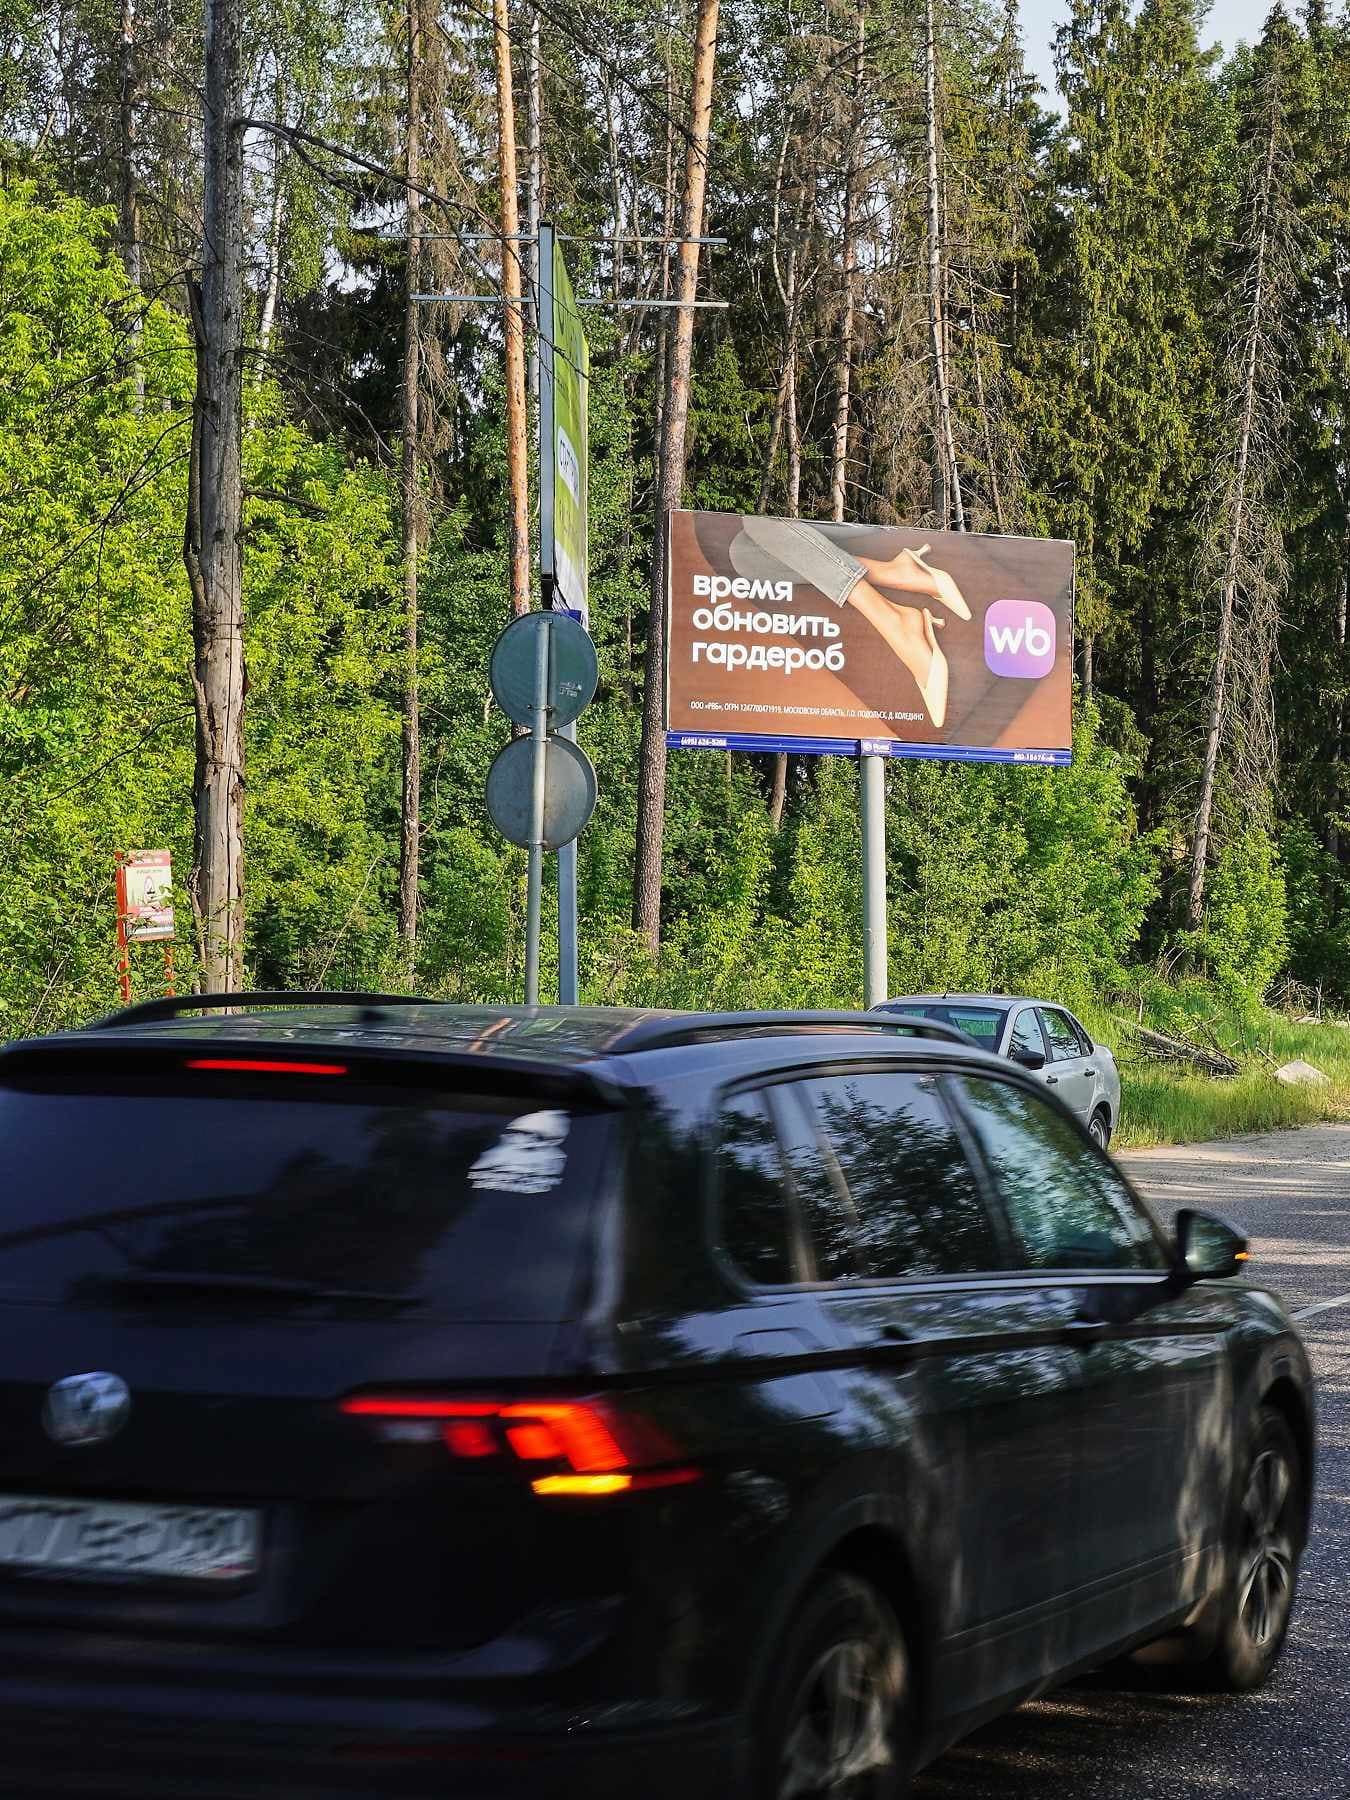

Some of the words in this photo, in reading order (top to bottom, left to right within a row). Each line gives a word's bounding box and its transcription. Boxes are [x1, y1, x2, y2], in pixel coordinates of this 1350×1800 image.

[693, 574, 793, 604] время
[692, 602, 841, 638] обновить
[989, 616, 1051, 657] wb
[691, 641, 845, 675] гардероб
[690, 701, 704, 710] ООО
[724, 703, 739, 712] ОГРН
